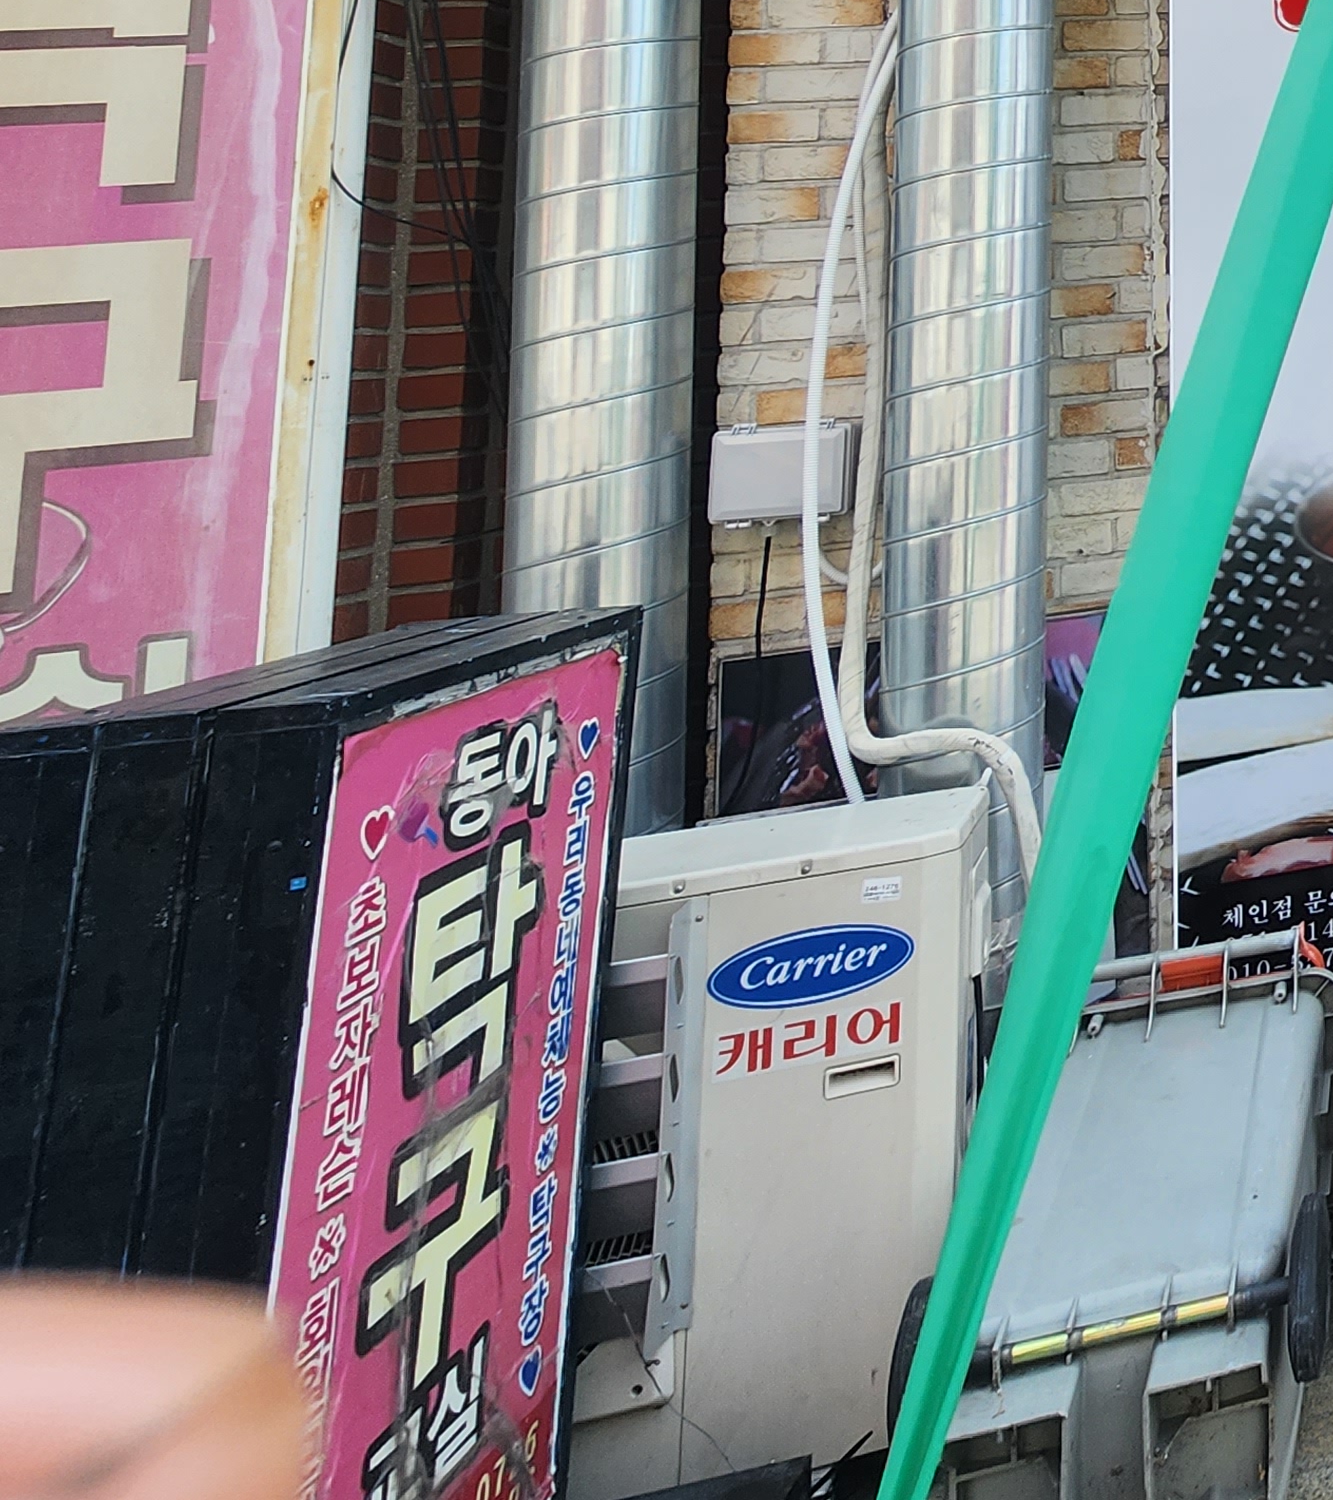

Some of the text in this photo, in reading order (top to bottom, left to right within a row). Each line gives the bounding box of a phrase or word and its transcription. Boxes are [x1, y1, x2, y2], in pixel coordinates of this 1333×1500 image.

[446, 709, 557, 838] 동아
[1221, 895, 1293, 929] 체인점
[738, 937, 889, 991] Carrier
[714, 1001, 902, 1076] 캐리어
